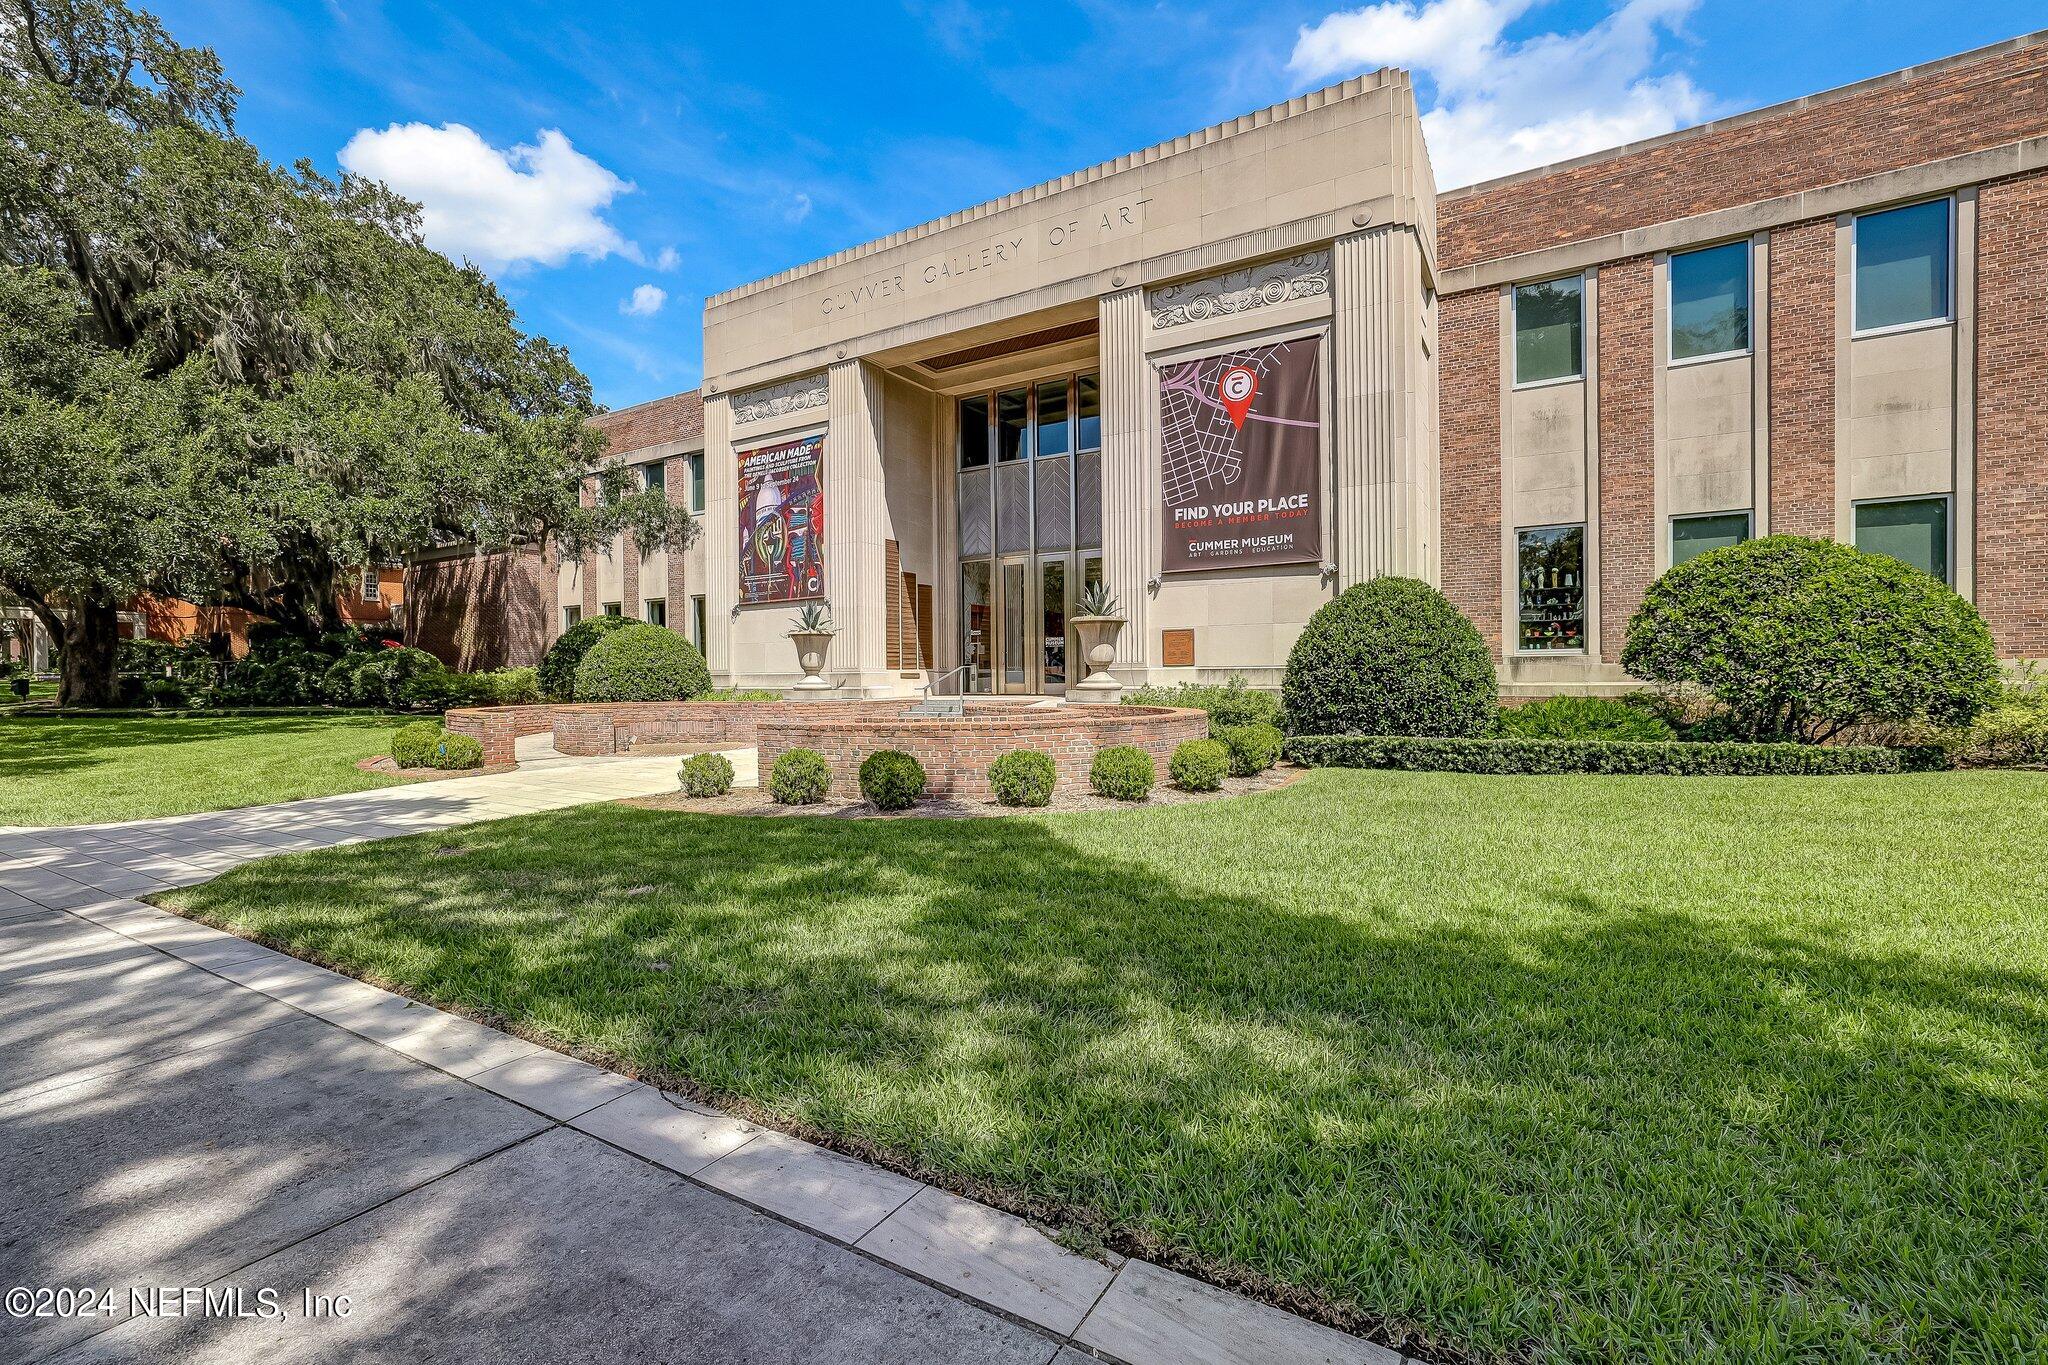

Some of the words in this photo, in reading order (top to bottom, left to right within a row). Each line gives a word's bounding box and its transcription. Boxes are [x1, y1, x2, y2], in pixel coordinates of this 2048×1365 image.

[923, 237, 1024, 284] GALLERY
[1049, 220, 1079, 247] OF
[1098, 198, 1154, 235] ART
[743, 450, 787, 468] AMERICAN
[787, 443, 812, 459] MADE
[765, 461, 775, 470] AND
[775, 458, 798, 468] SCULPTURE
[798, 454, 812, 463] FROM
[790, 459, 817, 470] COLLECTION
[765, 477, 792, 488] September
[792, 476, 799, 484] 24
[1174, 506, 1209, 521] FIND
[1212, 501, 1254, 518] YOUR
[1258, 494, 1308, 513] PLACE
[1174, 519, 1213, 529] BECOME
[1217, 518, 1224, 526] A
[1228, 513, 1270, 525] MEMBER
[1274, 508, 1309, 520] TODAY
[1188, 539, 1239, 552] CUMMER
[1241, 533, 1293, 549] MUSEUM
[1188, 551, 1202, 559] ART
[1209, 549, 1243, 557] GARDENS
[1252, 543, 1294, 554] EDUCATION
